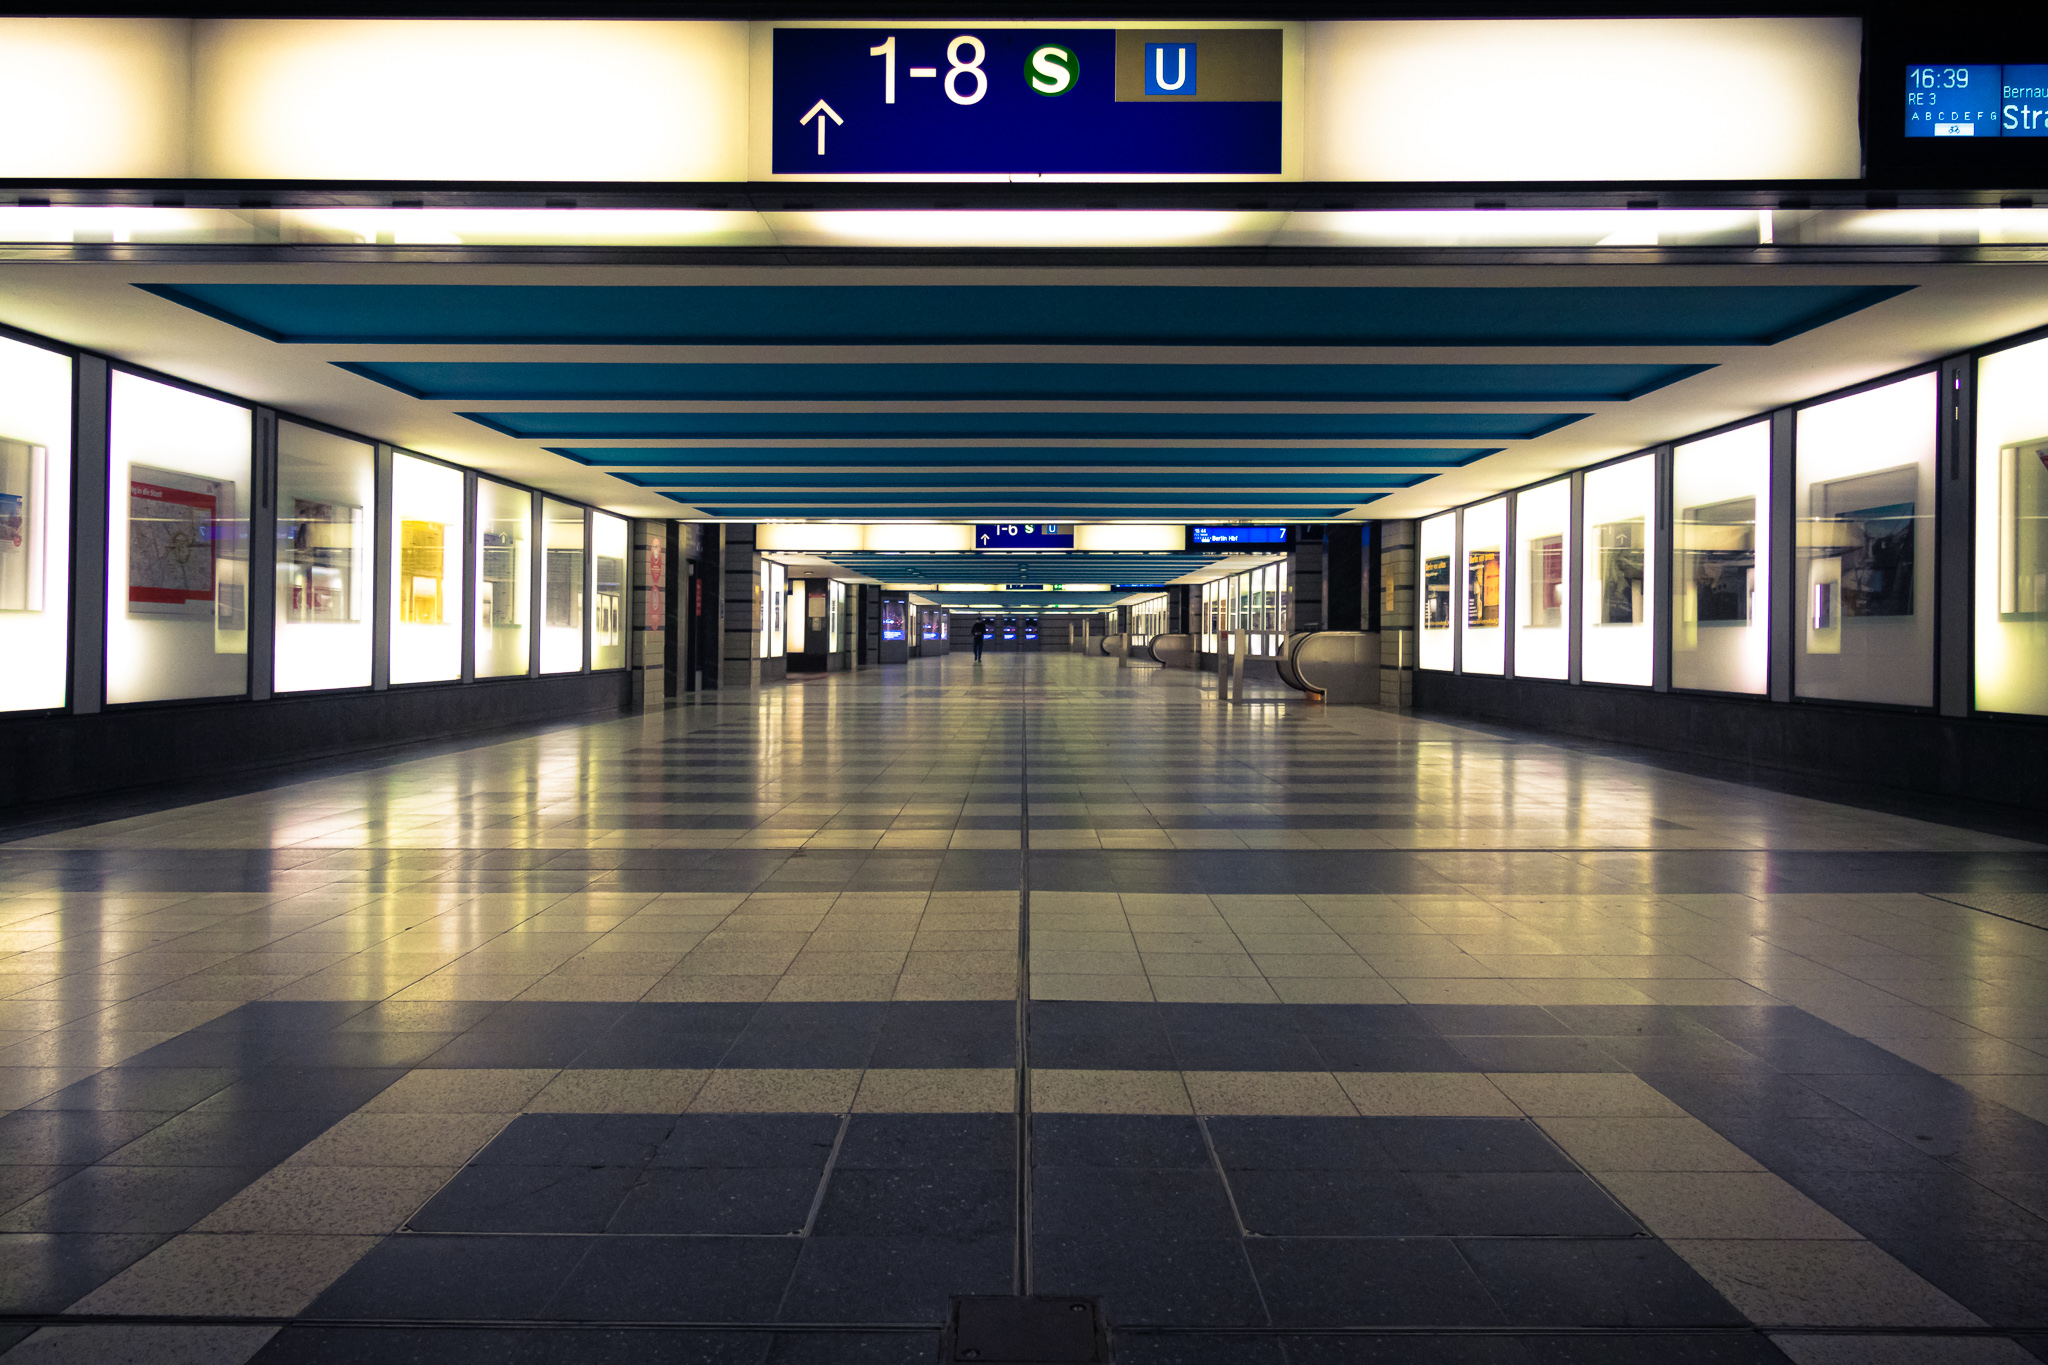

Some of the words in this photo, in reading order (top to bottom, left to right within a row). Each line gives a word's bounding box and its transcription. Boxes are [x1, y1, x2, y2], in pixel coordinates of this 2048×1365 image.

[869, 35, 988, 106] 1-8
[1031, 46, 1071, 94] S
[1155, 47, 1186, 91] U
[1910, 68, 1969, 89] 16:39
[1908, 92, 1924, 105] RE
[1928, 92, 1936, 105] 3
[1911, 111, 1919, 121] A
[1925, 111, 1932, 121] B
[1938, 111, 1945, 121] C
[1951, 111, 1959, 121] D
[1964, 111, 1971, 121] E
[1977, 111, 1983, 121] F
[1990, 111, 1997, 121] G
[1279, 528, 1287, 539] 7
